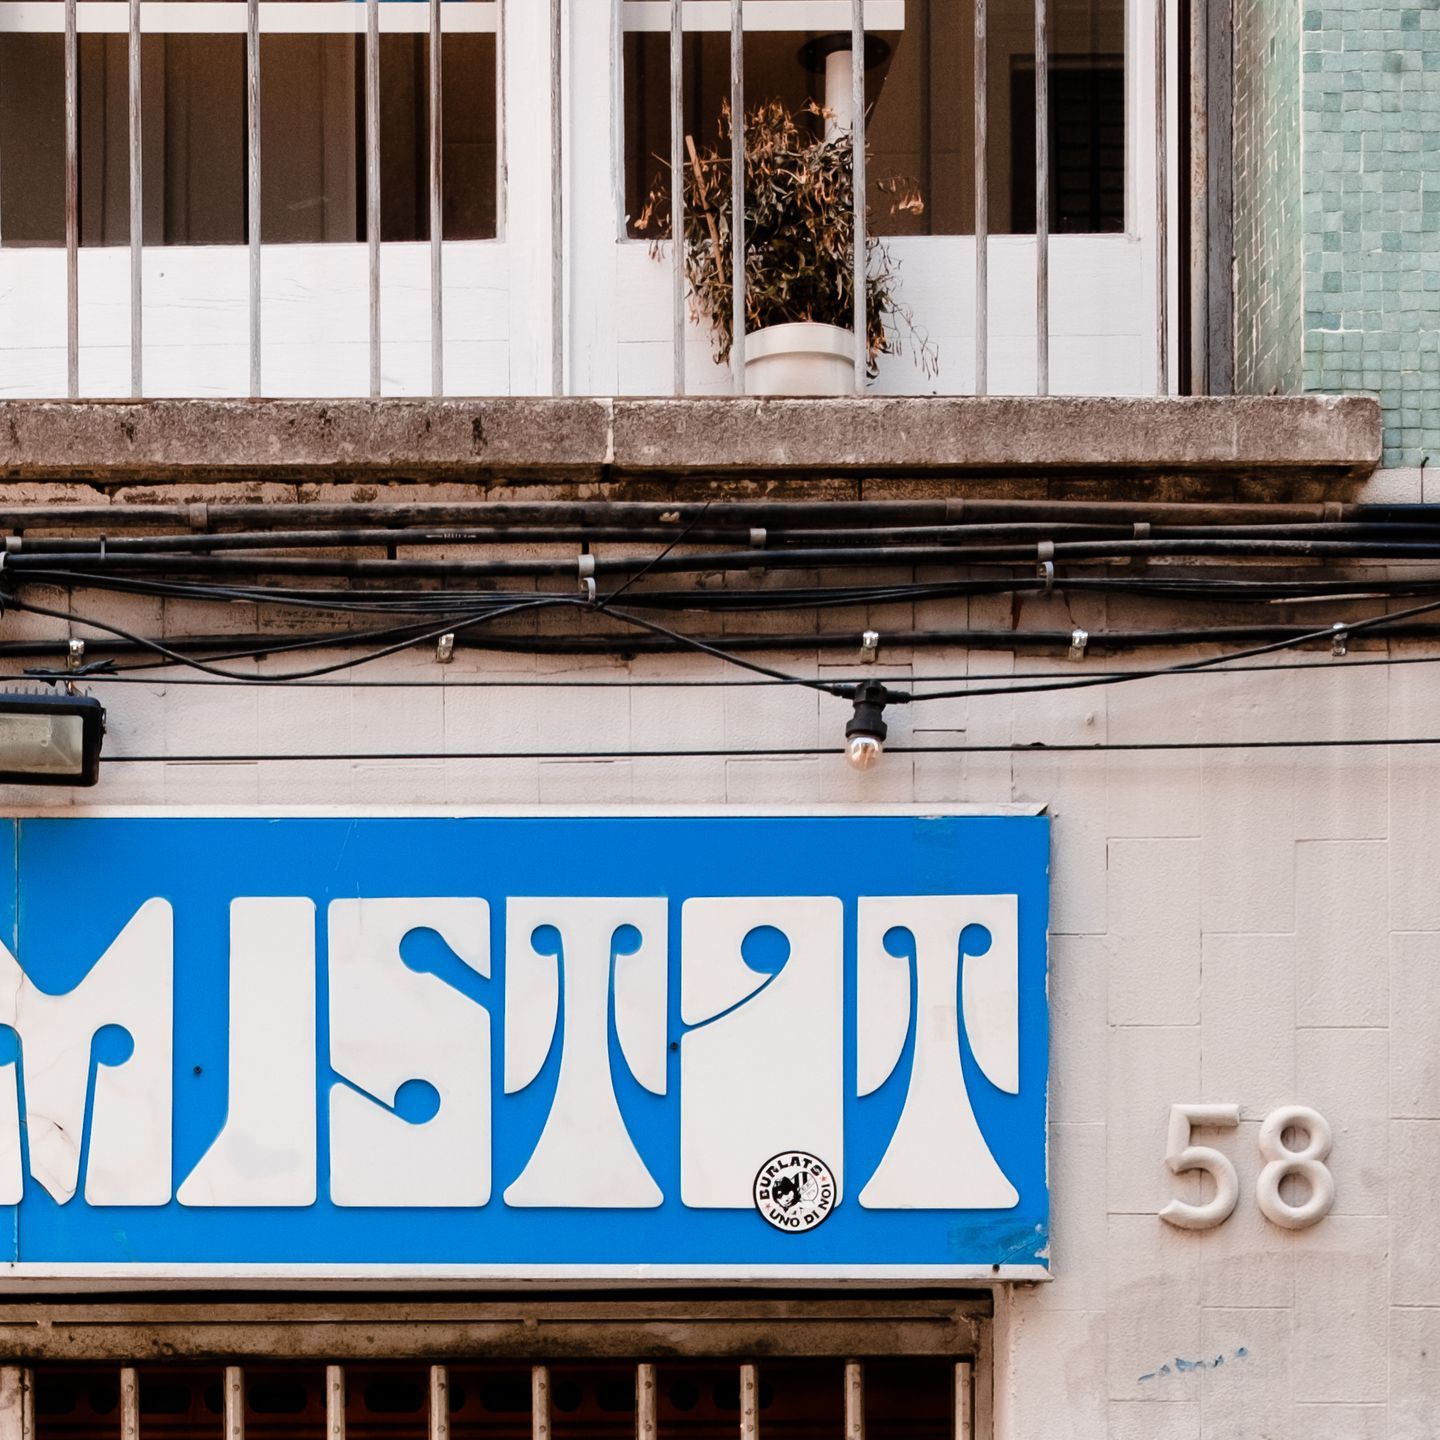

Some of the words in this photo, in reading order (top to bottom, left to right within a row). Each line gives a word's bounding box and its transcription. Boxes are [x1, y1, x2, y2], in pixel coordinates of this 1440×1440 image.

[759, 1156, 823, 1200] BURLATS
[1159, 1103, 1335, 1230] 58
[769, 1208, 800, 1228] UNO
[803, 1210, 820, 1225] DI
[818, 1183, 832, 1210] NOI
